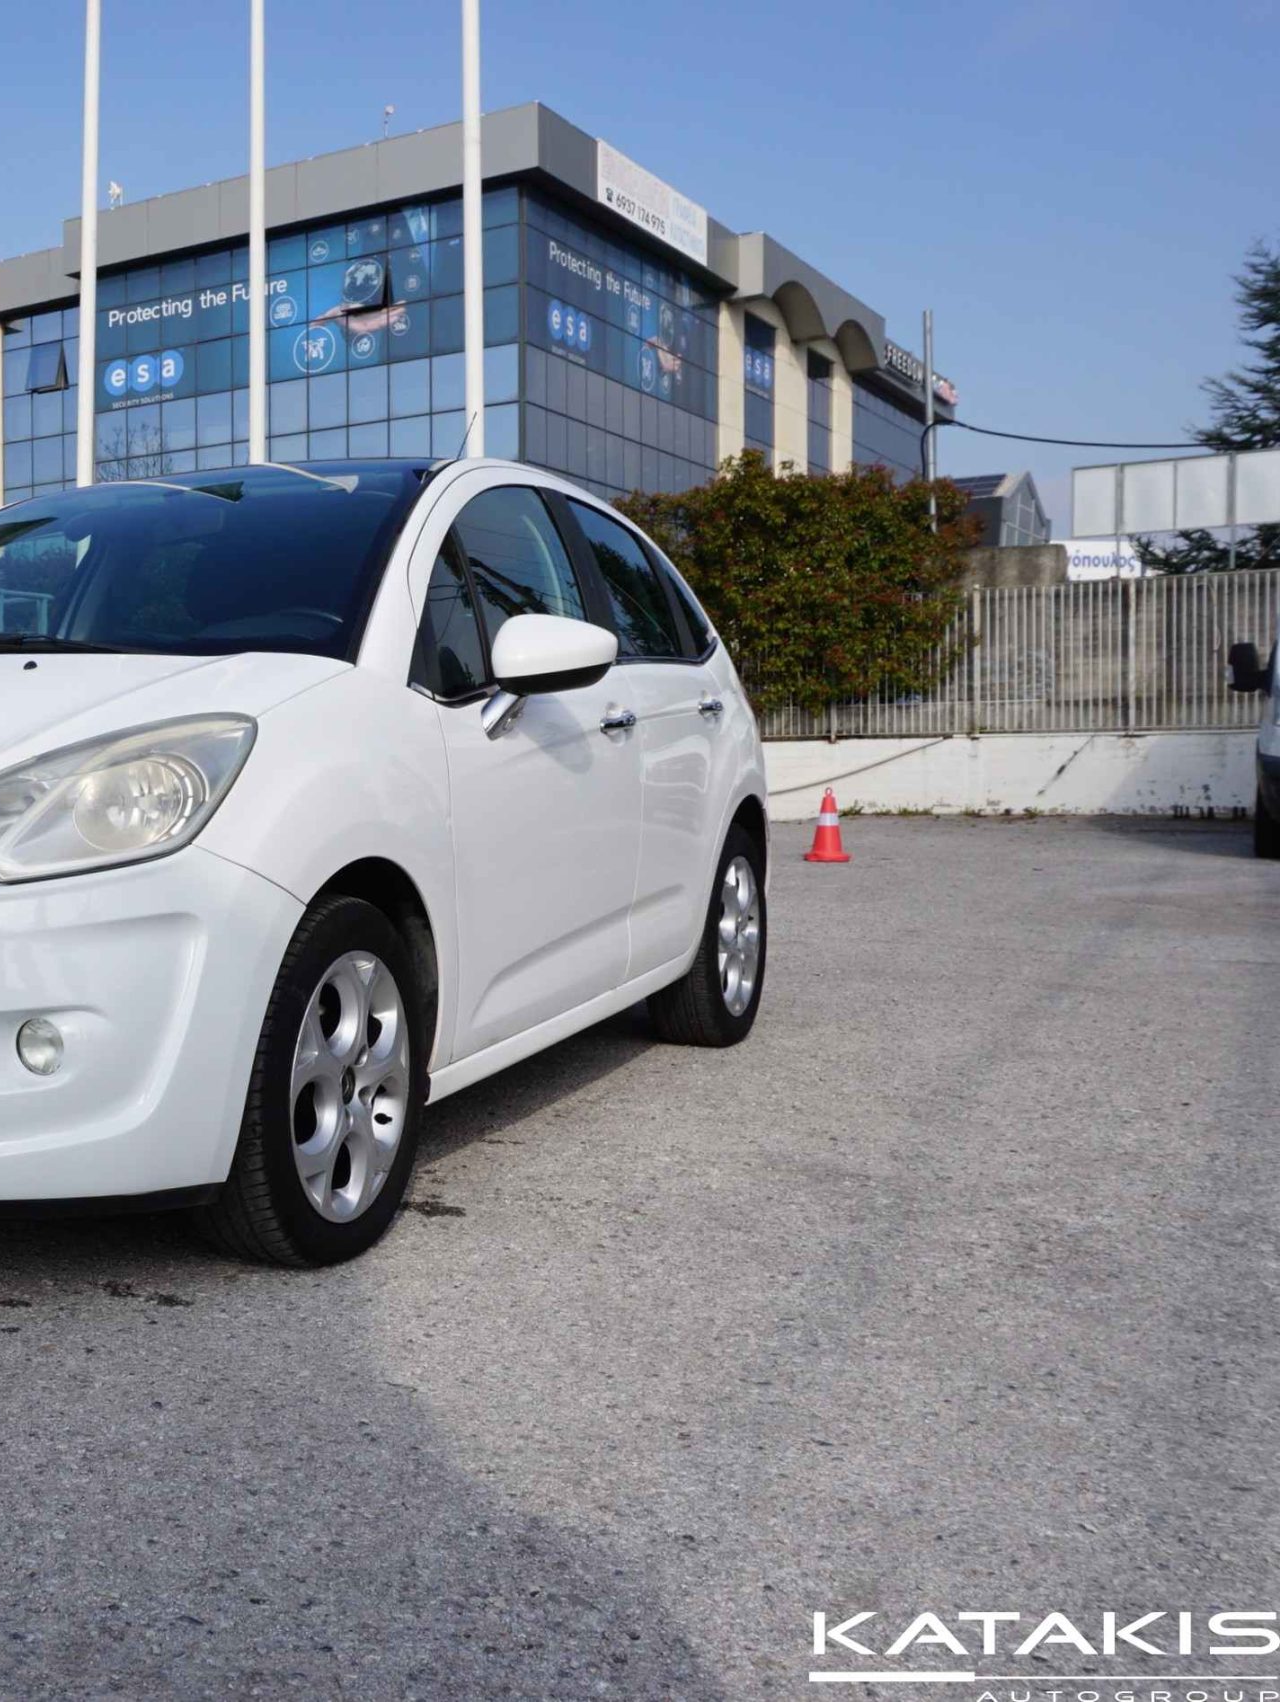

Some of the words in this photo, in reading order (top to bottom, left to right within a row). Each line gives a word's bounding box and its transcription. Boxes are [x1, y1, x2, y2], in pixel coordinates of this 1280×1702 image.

[549, 241, 601, 290] Protecting
[606, 272, 621, 294] the
[624, 281, 651, 310] Future
[108, 298, 192, 328] Protecting
[200, 289, 227, 309] the
[552, 309, 587, 342] esa
[110, 358, 176, 388] esa
